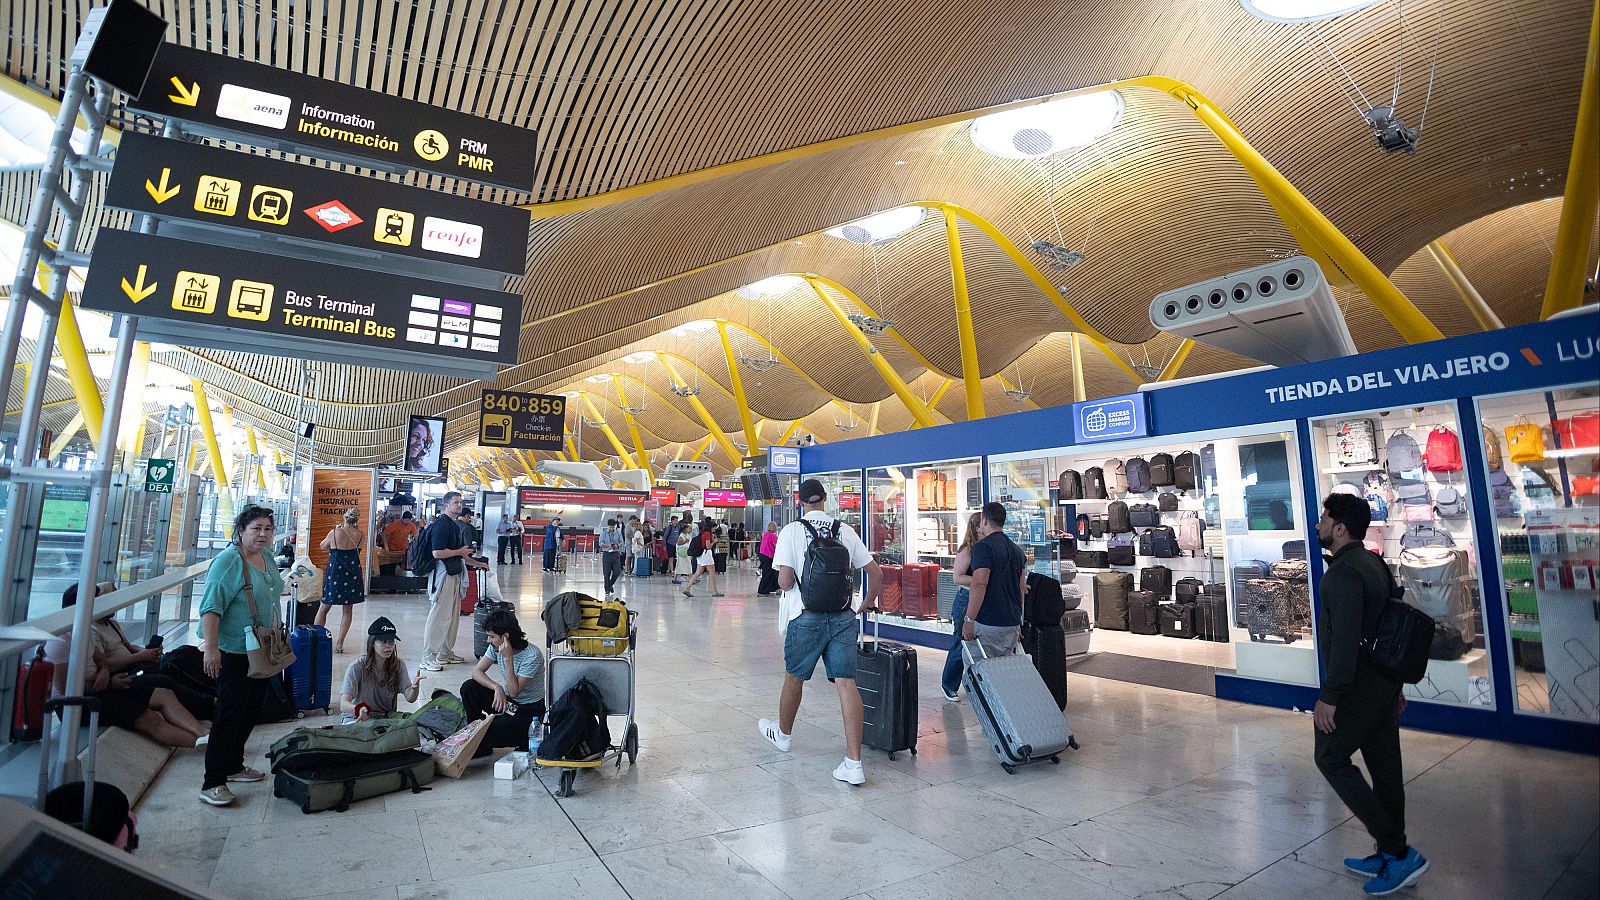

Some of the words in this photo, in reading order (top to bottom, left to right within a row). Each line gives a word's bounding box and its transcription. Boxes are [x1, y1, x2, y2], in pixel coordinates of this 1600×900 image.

[254, 104, 283, 116] aena
[301, 103, 375, 130] Information
[297, 118, 399, 153] Información
[460, 138, 488, 155] PRM
[457, 153, 493, 173] PMR
[428, 230, 477, 247] renfe
[285, 290, 312, 308] Bus
[317, 294, 375, 318] Terminal
[283, 308, 359, 335] Terminal
[364, 318, 396, 340] Bus
[1557, 337, 1600, 361] LU
[1264, 379, 1343, 404] TIENDA
[1346, 372, 1391, 392] DEL
[1393, 352, 1510, 385] VIAJERO
[484, 393, 520, 412] 840
[528, 397, 563, 415] 859
[1108, 409, 1130, 418] EXCESS
[1108, 420, 1131, 428] COMPANY
[514, 430, 561, 442] Facturación
[148, 483, 170, 493] DEA
[318, 487, 361, 496] WRAPPING
[318, 498, 359, 506] INSURANCE
[319, 507, 349, 515] TRACKI
